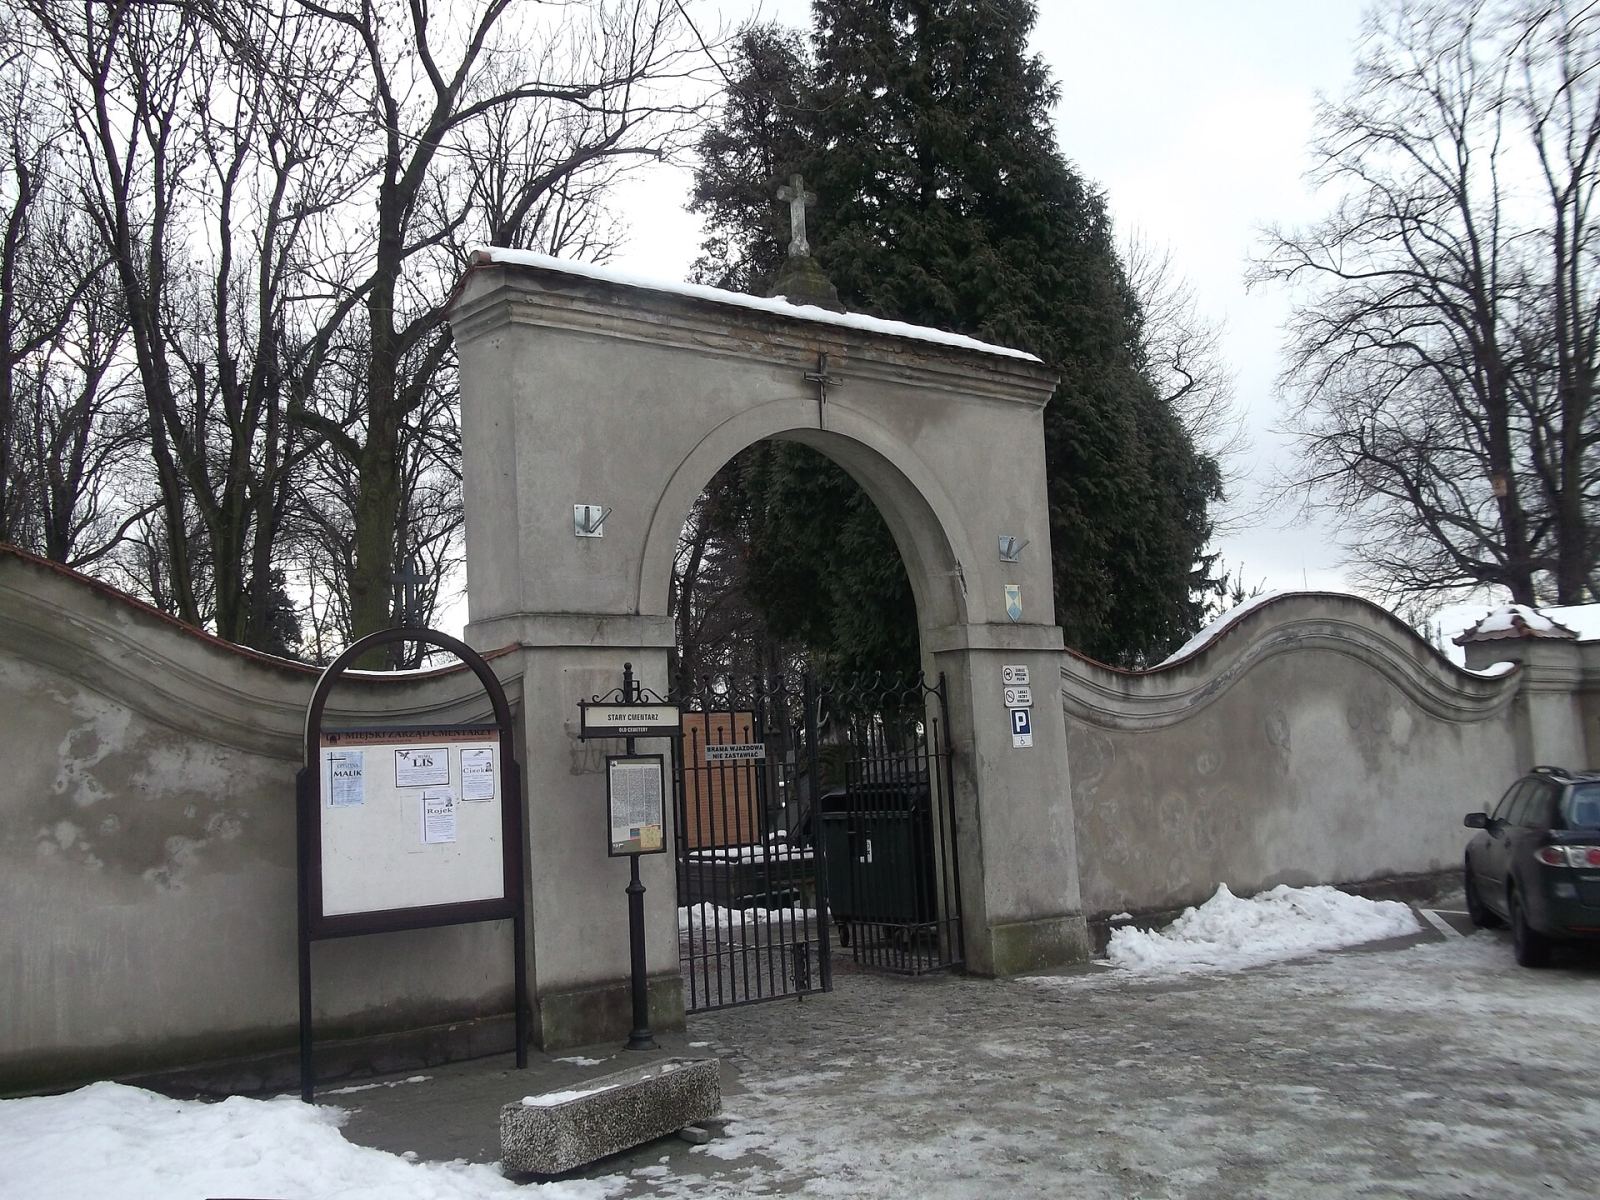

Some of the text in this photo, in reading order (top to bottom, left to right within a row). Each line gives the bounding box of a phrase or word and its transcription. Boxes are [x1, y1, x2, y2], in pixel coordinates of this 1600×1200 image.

[607, 713, 659, 721] STARY CMENTARZ
[1015, 712, 1026, 732] P
[724, 751, 759, 759] ZASTAWIAĆ
[333, 769, 362, 777] MALIK
